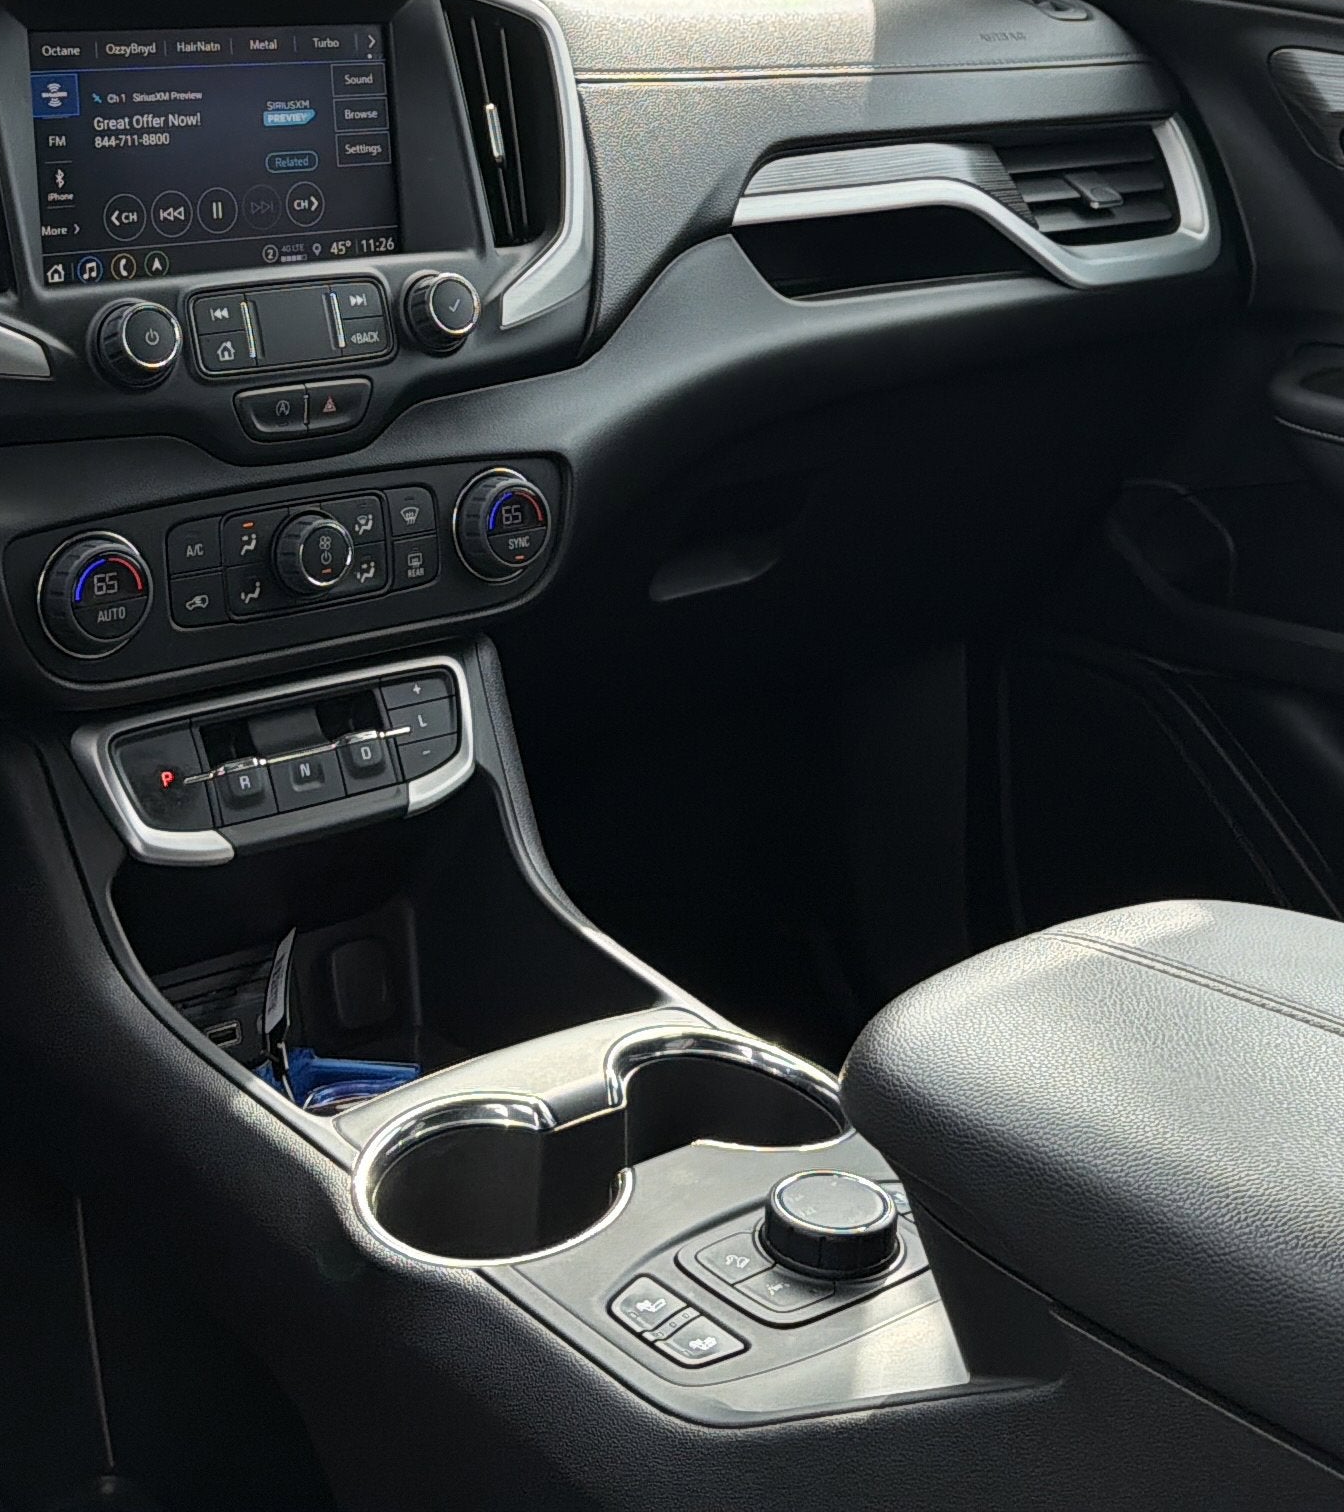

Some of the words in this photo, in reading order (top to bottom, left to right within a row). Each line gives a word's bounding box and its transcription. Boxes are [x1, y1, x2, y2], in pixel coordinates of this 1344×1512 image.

[42, 44, 80, 57] Octane
[105, 42, 156, 56] OzzyBnyd
[176, 40, 220, 53] HairNatn
[249, 38, 278, 51] Metal
[312, 36, 340, 50] Turbo
[344, 72, 374, 86] Sound
[107, 92, 120, 104] Ch
[132, 92, 170, 102] SiriusXM
[170, 90, 203, 102] Preview
[266, 100, 310, 109] SIRIUSXM
[344, 108, 378, 120] Browse
[94, 115, 130, 132] Great
[132, 114, 165, 130] Offer
[168, 112, 202, 128] Now!
[48, 134, 66, 148] FM
[94, 133, 170, 149] 844-711-8800
[344, 142, 382, 156] Settings
[274, 156, 310, 168] Related
[48, 192, 74, 203] iPhone
[293, 198, 309, 210] CH
[122, 211, 138, 224] CH
[42, 224, 68, 236] More
[330, 240, 352, 256] 45°
[361, 238, 395, 253] 11:26
[356, 330, 380, 345] BACK
[502, 506, 522, 525] 65
[508, 536, 531, 551] SYNC
[186, 543, 204, 559] A/C
[407, 565, 425, 579] REAR
[93, 573, 118, 594] 65
[97, 606, 126, 624] AUTO
[417, 714, 428, 728] L
[360, 746, 372, 762] D
[300, 763, 311, 777] N
[160, 770, 175, 788] P
[240, 776, 251, 789] R
